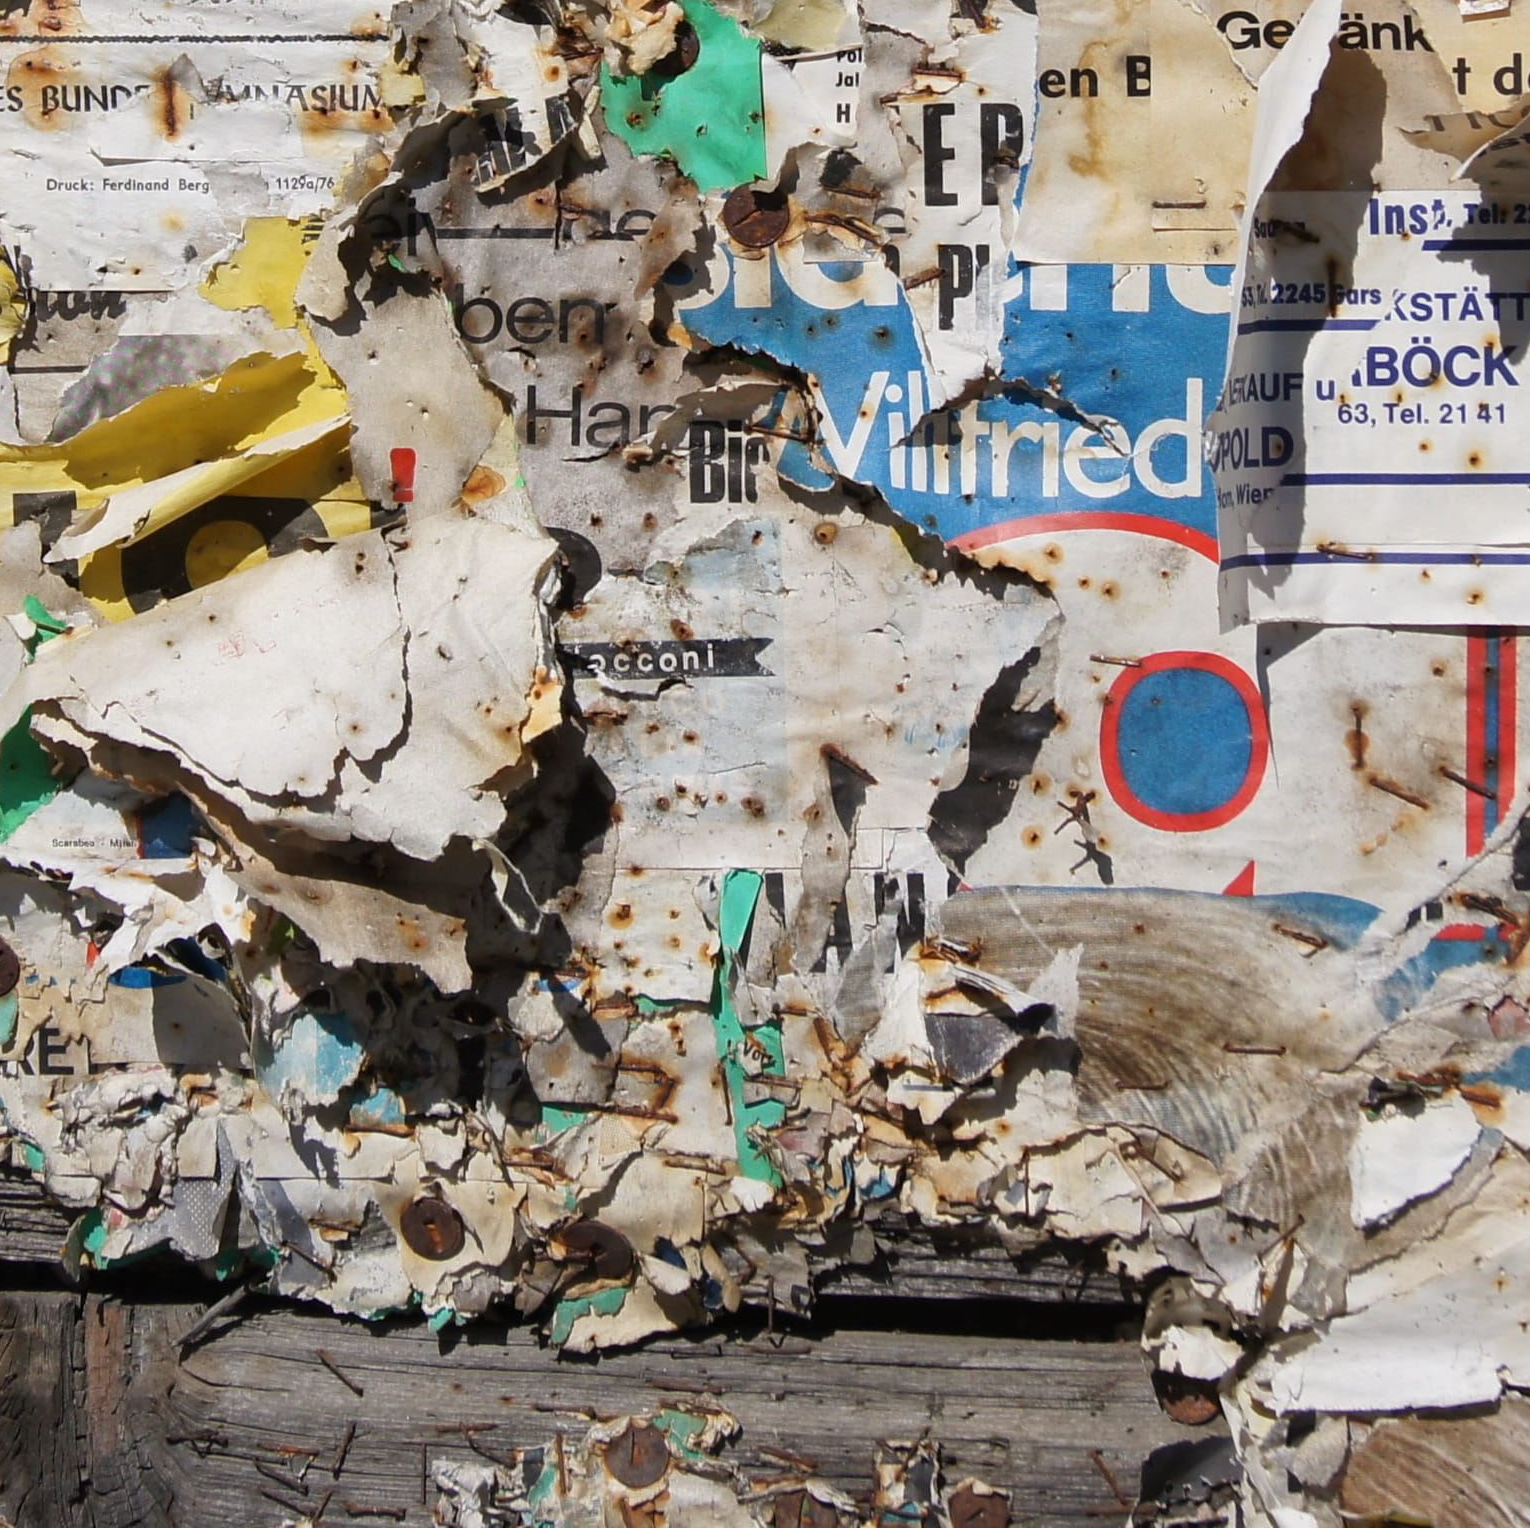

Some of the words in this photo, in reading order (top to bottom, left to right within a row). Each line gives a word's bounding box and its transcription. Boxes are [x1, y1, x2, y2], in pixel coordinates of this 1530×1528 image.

[1215, 11, 1436, 52] Geänk
[45, 177, 95, 193] Druck:
[101, 177, 170, 192] Ferdinand
[1270, 281, 1327, 305] 2245
[1337, 402, 1377, 427] 63,
[1383, 402, 1429, 423] Tel.
